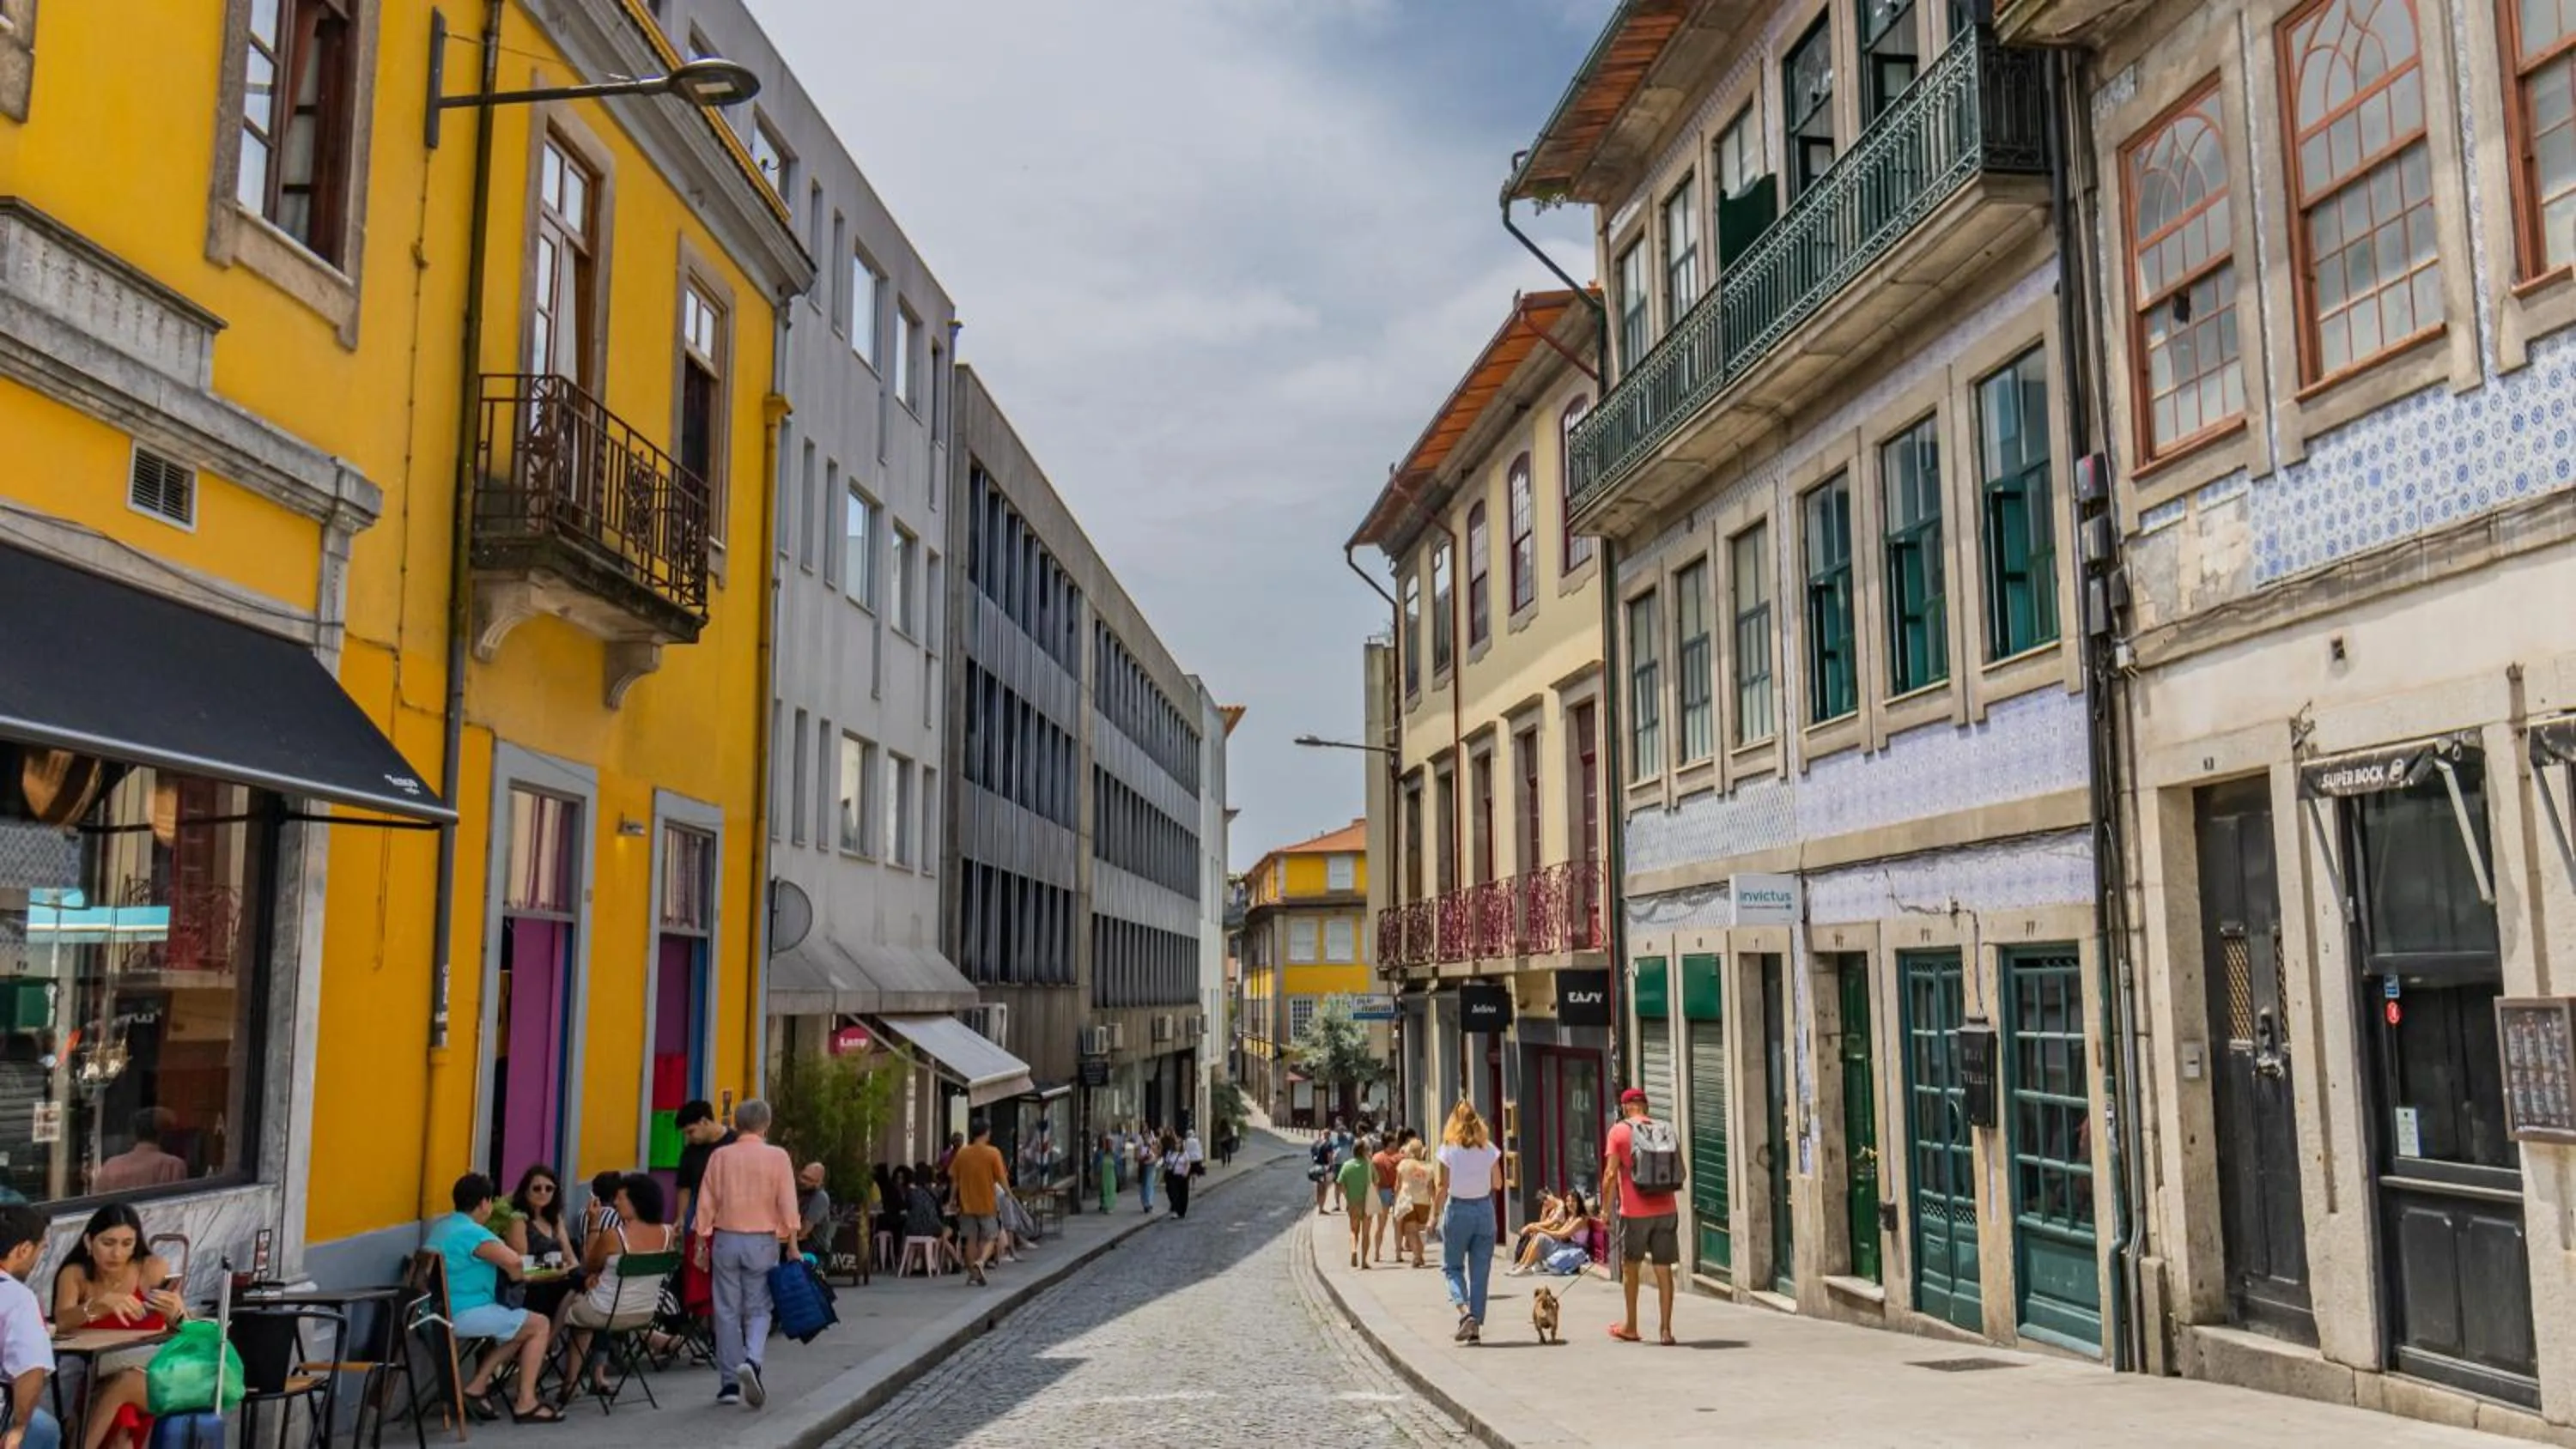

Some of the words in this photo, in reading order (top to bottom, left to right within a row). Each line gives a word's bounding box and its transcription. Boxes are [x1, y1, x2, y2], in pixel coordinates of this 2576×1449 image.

[2322, 768, 2353, 788] SUPER
[2354, 765, 2385, 785] BOCK
[1739, 888, 1792, 901] invictus
